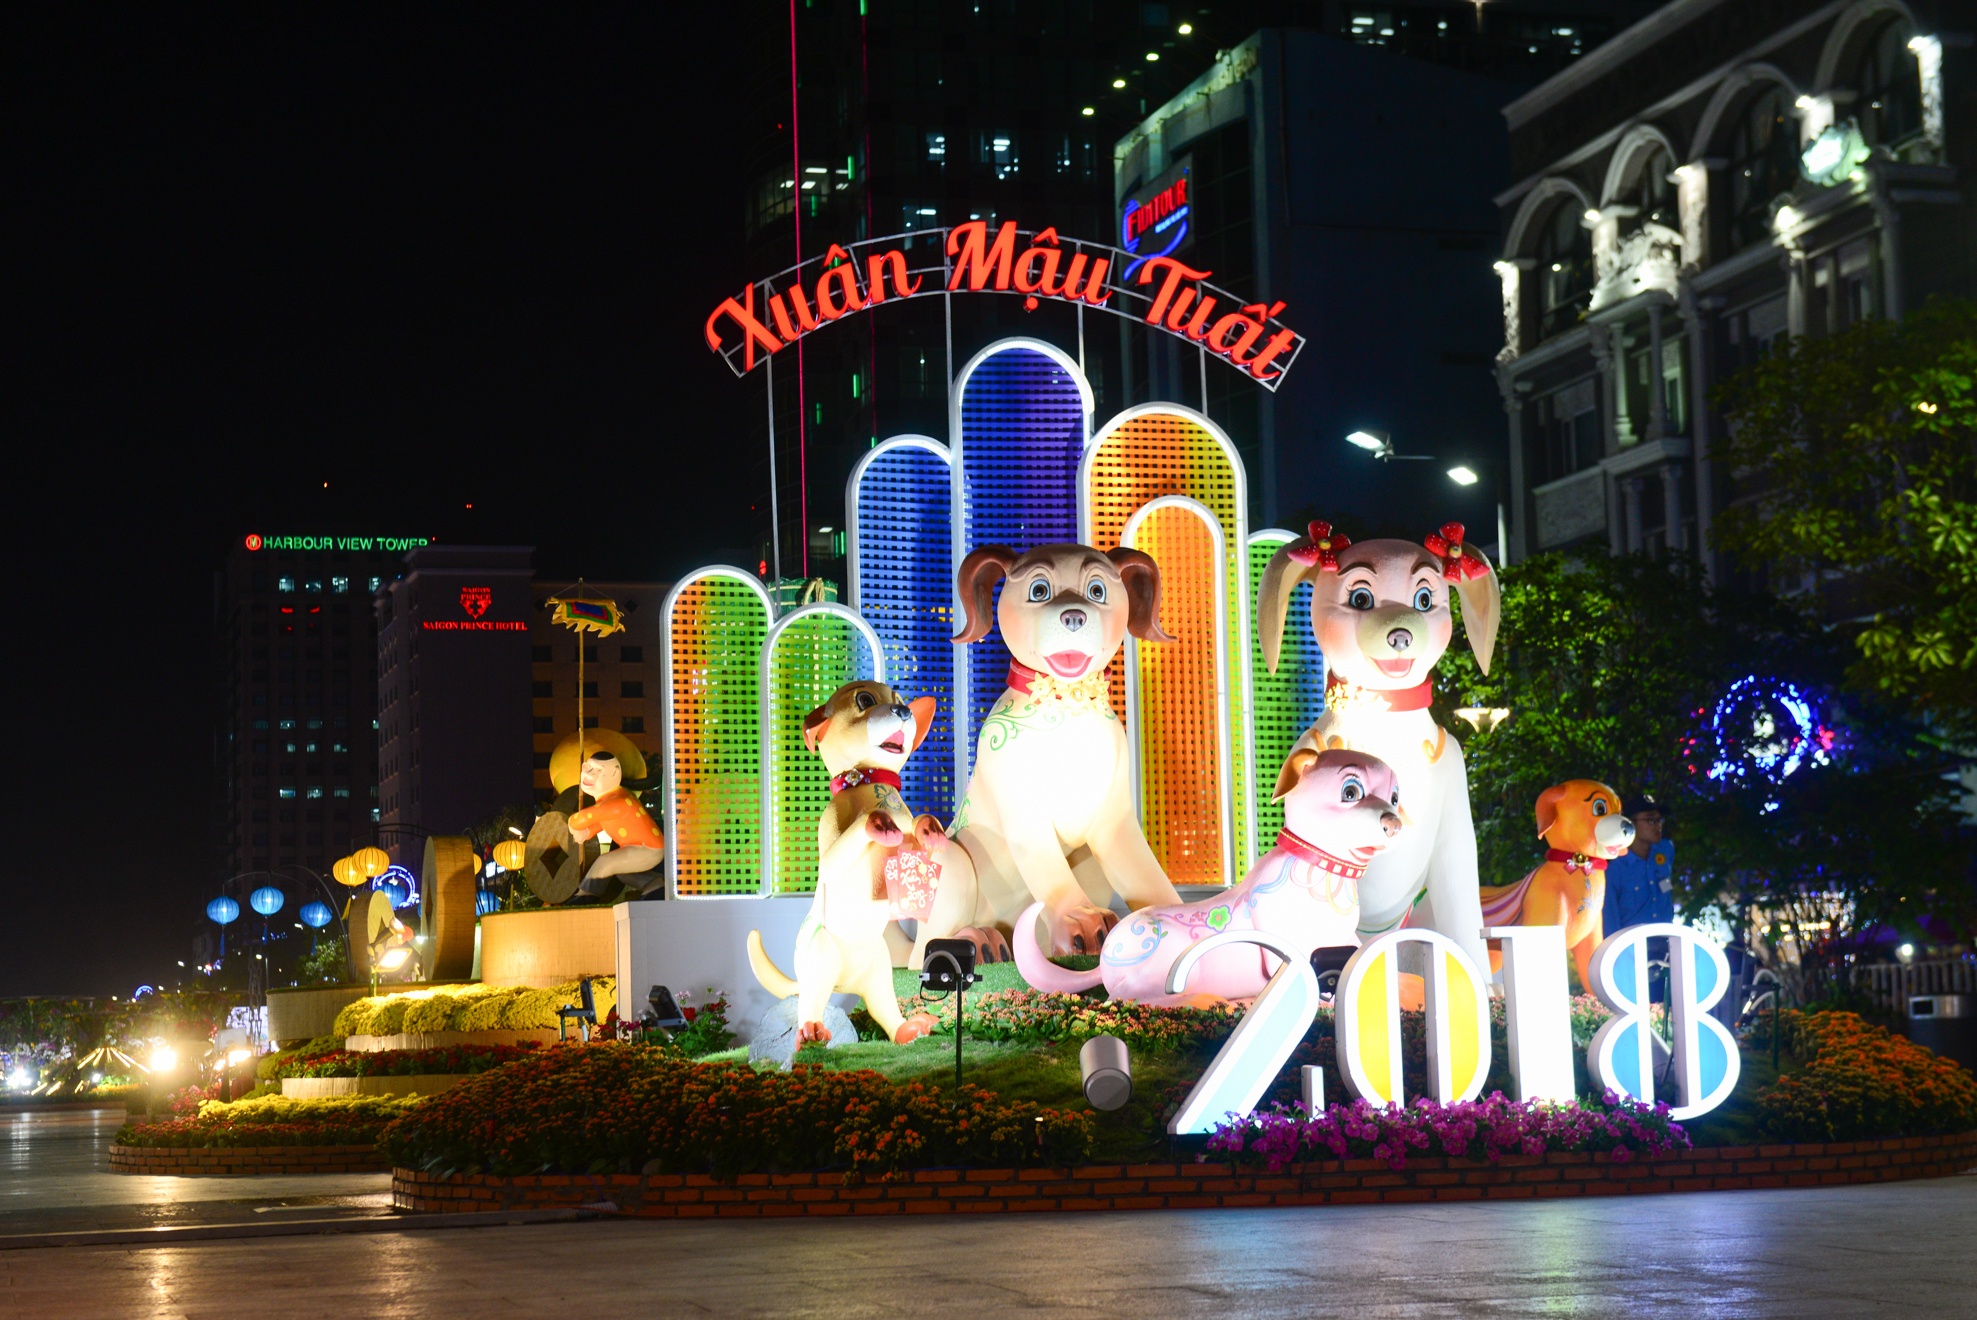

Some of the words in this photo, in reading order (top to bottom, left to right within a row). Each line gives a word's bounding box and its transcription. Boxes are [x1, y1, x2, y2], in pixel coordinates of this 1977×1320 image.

[706, 243, 923, 372] Xuân
[947, 221, 1113, 313] Mậu
[1137, 256, 1296, 380] Tuất
[263, 536, 333, 550] HARBOUR
[336, 537, 374, 551] VIEW
[461, 586, 492, 594] SAIGON
[460, 593, 492, 601] PRINCE
[423, 621, 459, 631] SAIGON
[460, 621, 495, 631] PRINCE
[495, 621, 528, 631] HOTEL
[1165, 922, 1742, 1135] 2018
